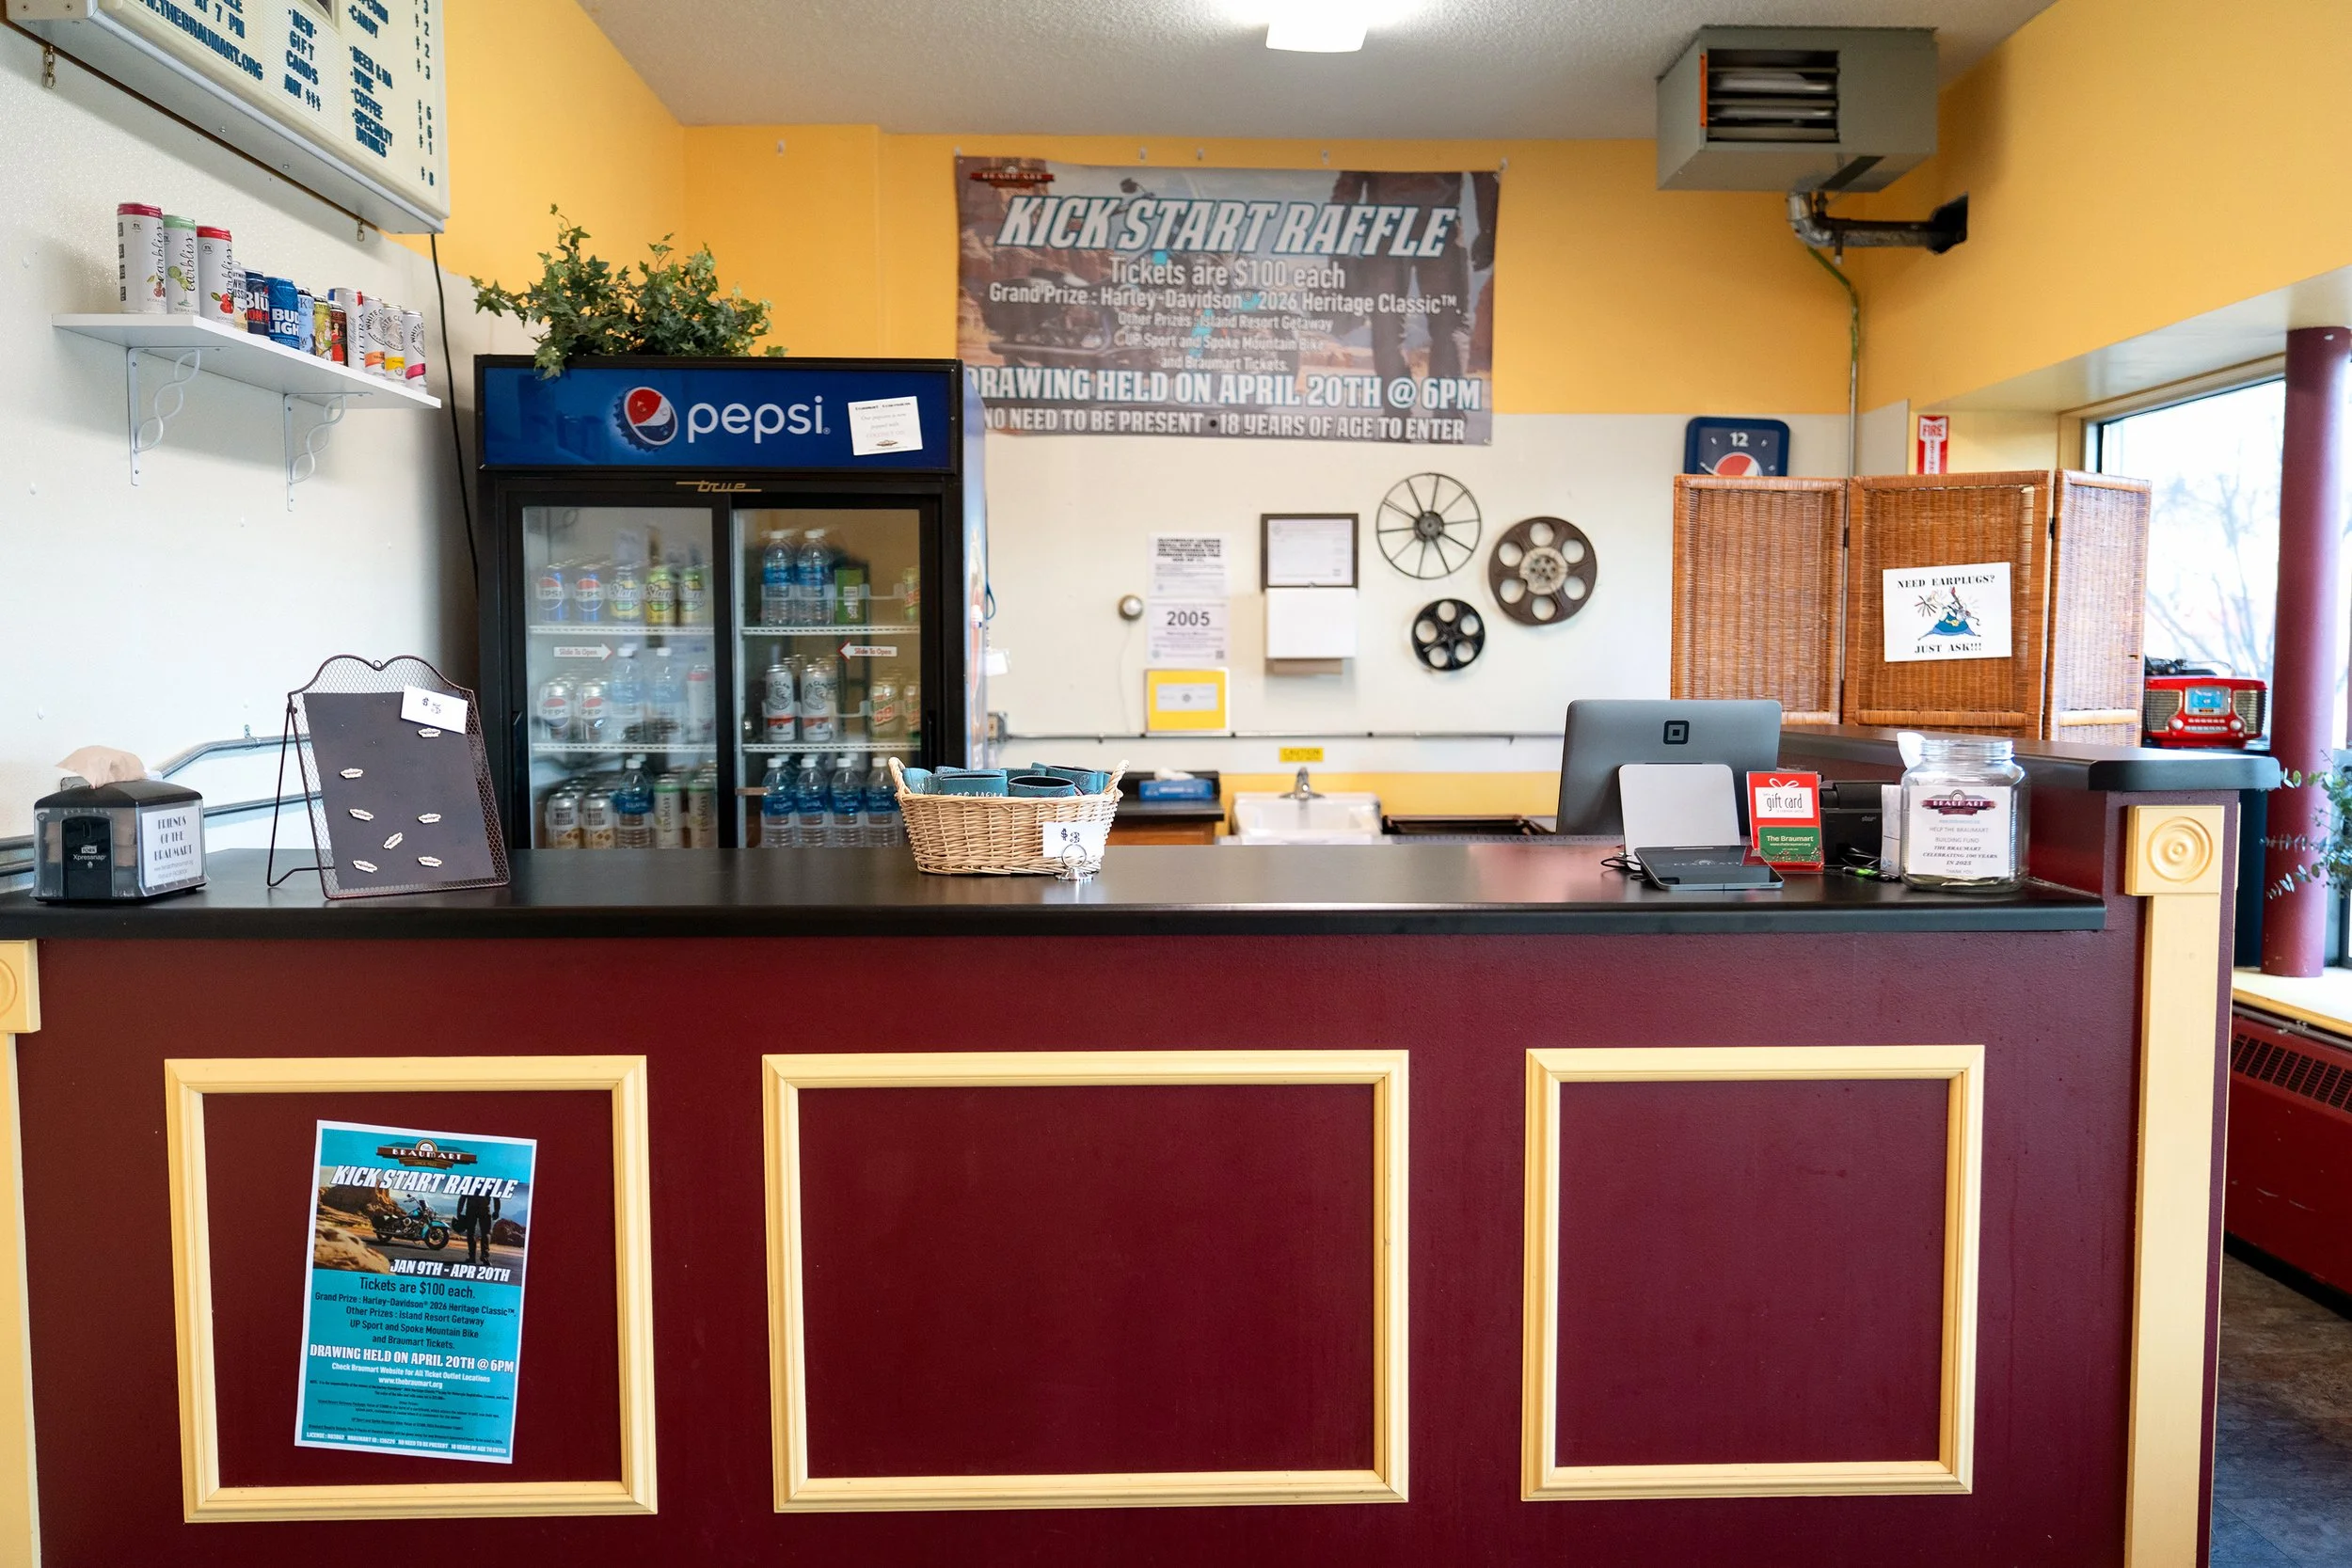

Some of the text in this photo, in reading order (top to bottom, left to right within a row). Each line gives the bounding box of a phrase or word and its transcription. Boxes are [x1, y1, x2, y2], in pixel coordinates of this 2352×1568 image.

[215, 3, 222, 23] 7
[229, 13, 245, 39] PM
[290, 30, 314, 60] GIFT
[286, 50, 319, 86] CARDS
[284, 73, 302, 99] ANY
[354, 88, 384, 120] COFFEE
[354, 108, 393, 147] SPECIALTY
[356, 125, 386, 158] DRINKS
[995, 196, 1458, 257] KICK START RAFFLE
[1109, 257, 1345, 290] Tickets are $100 each
[990, 282, 1041, 303] Grand
[1044, 284, 1088, 305] Prize
[1258, 293, 1296, 310] 2026
[1302, 293, 1374, 316] Heritage
[1118, 311, 1334, 333] Other Prizes Island Resort Getaway
[1144, 333, 1177, 349] Sport
[1179, 335, 1201, 348] and
[1203, 335, 1240, 351] Spoke
[1242, 337, 1296, 351] Mountain
[1299, 337, 1325, 352] Bike
[1161, 356, 1184, 369] and
[1185, 356, 1242, 371] Braumart
[1097, 371, 1168, 403] HELD
[1176, 372, 1211, 404] ON
[1217, 372, 1300, 406] APRIL
[1306, 375, 1382, 408] 20TH
[1387, 378, 1417, 409] @
[1422, 378, 1481, 410] 6PM
[1009, 408, 1057, 431] NEED
[1061, 409, 1088, 431] TO
[1091, 410, 1114, 432] BE
[1120, 412, 1204, 434] PRESENT
[1220, 413, 1240, 436] 18
[1244, 414, 1305, 436] YEARS
[1309, 416, 1332, 438] OF
[1336, 416, 1374, 438] AGE
[1377, 417, 1403, 440] TO
[1406, 418, 1465, 440] ENTER
[1922, 424, 1943, 436] FIRE
[1729, 432, 1749, 448] 12
[1897, 574, 1995, 589] NEED EARPLUGS?
[1167, 611, 1210, 626] 2005
[581, 649, 597, 657] Open
[854, 647, 892, 657] Slide To Open
[1915, 642, 1981, 655] JUST ASK!!!
[1767, 792, 1803, 812] gift card
[391, 1148, 461, 1161] BRAUMART
[331, 1164, 519, 1200] KICK START RAFFLE
[389, 1259, 512, 1282] JAN 9TH APR 20TH
[359, 1276, 476, 1298] Tickets are $100 each.
[315, 1291, 337, 1301] Grand
[339, 1294, 358, 1303] Prize
[430, 1302, 447, 1310] 2026
[449, 1304, 479, 1314] Heritage
[346, 1306, 485, 1327] Other Prizes Island Resort Getaway
[350, 1319, 479, 1338] UP Sport and Spoke Mountain Bike
[388, 1336, 423, 1346] Braumart
[310, 1344, 515, 1373] DRAWING HELD ON APRIL 20TH @ 6PM
[332, 1362, 350, 1370] Check
[351, 1364, 379, 1373] Braumart
[380, 1367, 404, 1375] Website
[424, 1370, 442, 1378] Ticket
[443, 1371, 461, 1380] Outlet
[462, 1373, 490, 1383] Locations
[378, 1377, 443, 1389] www.thebraumart.org
